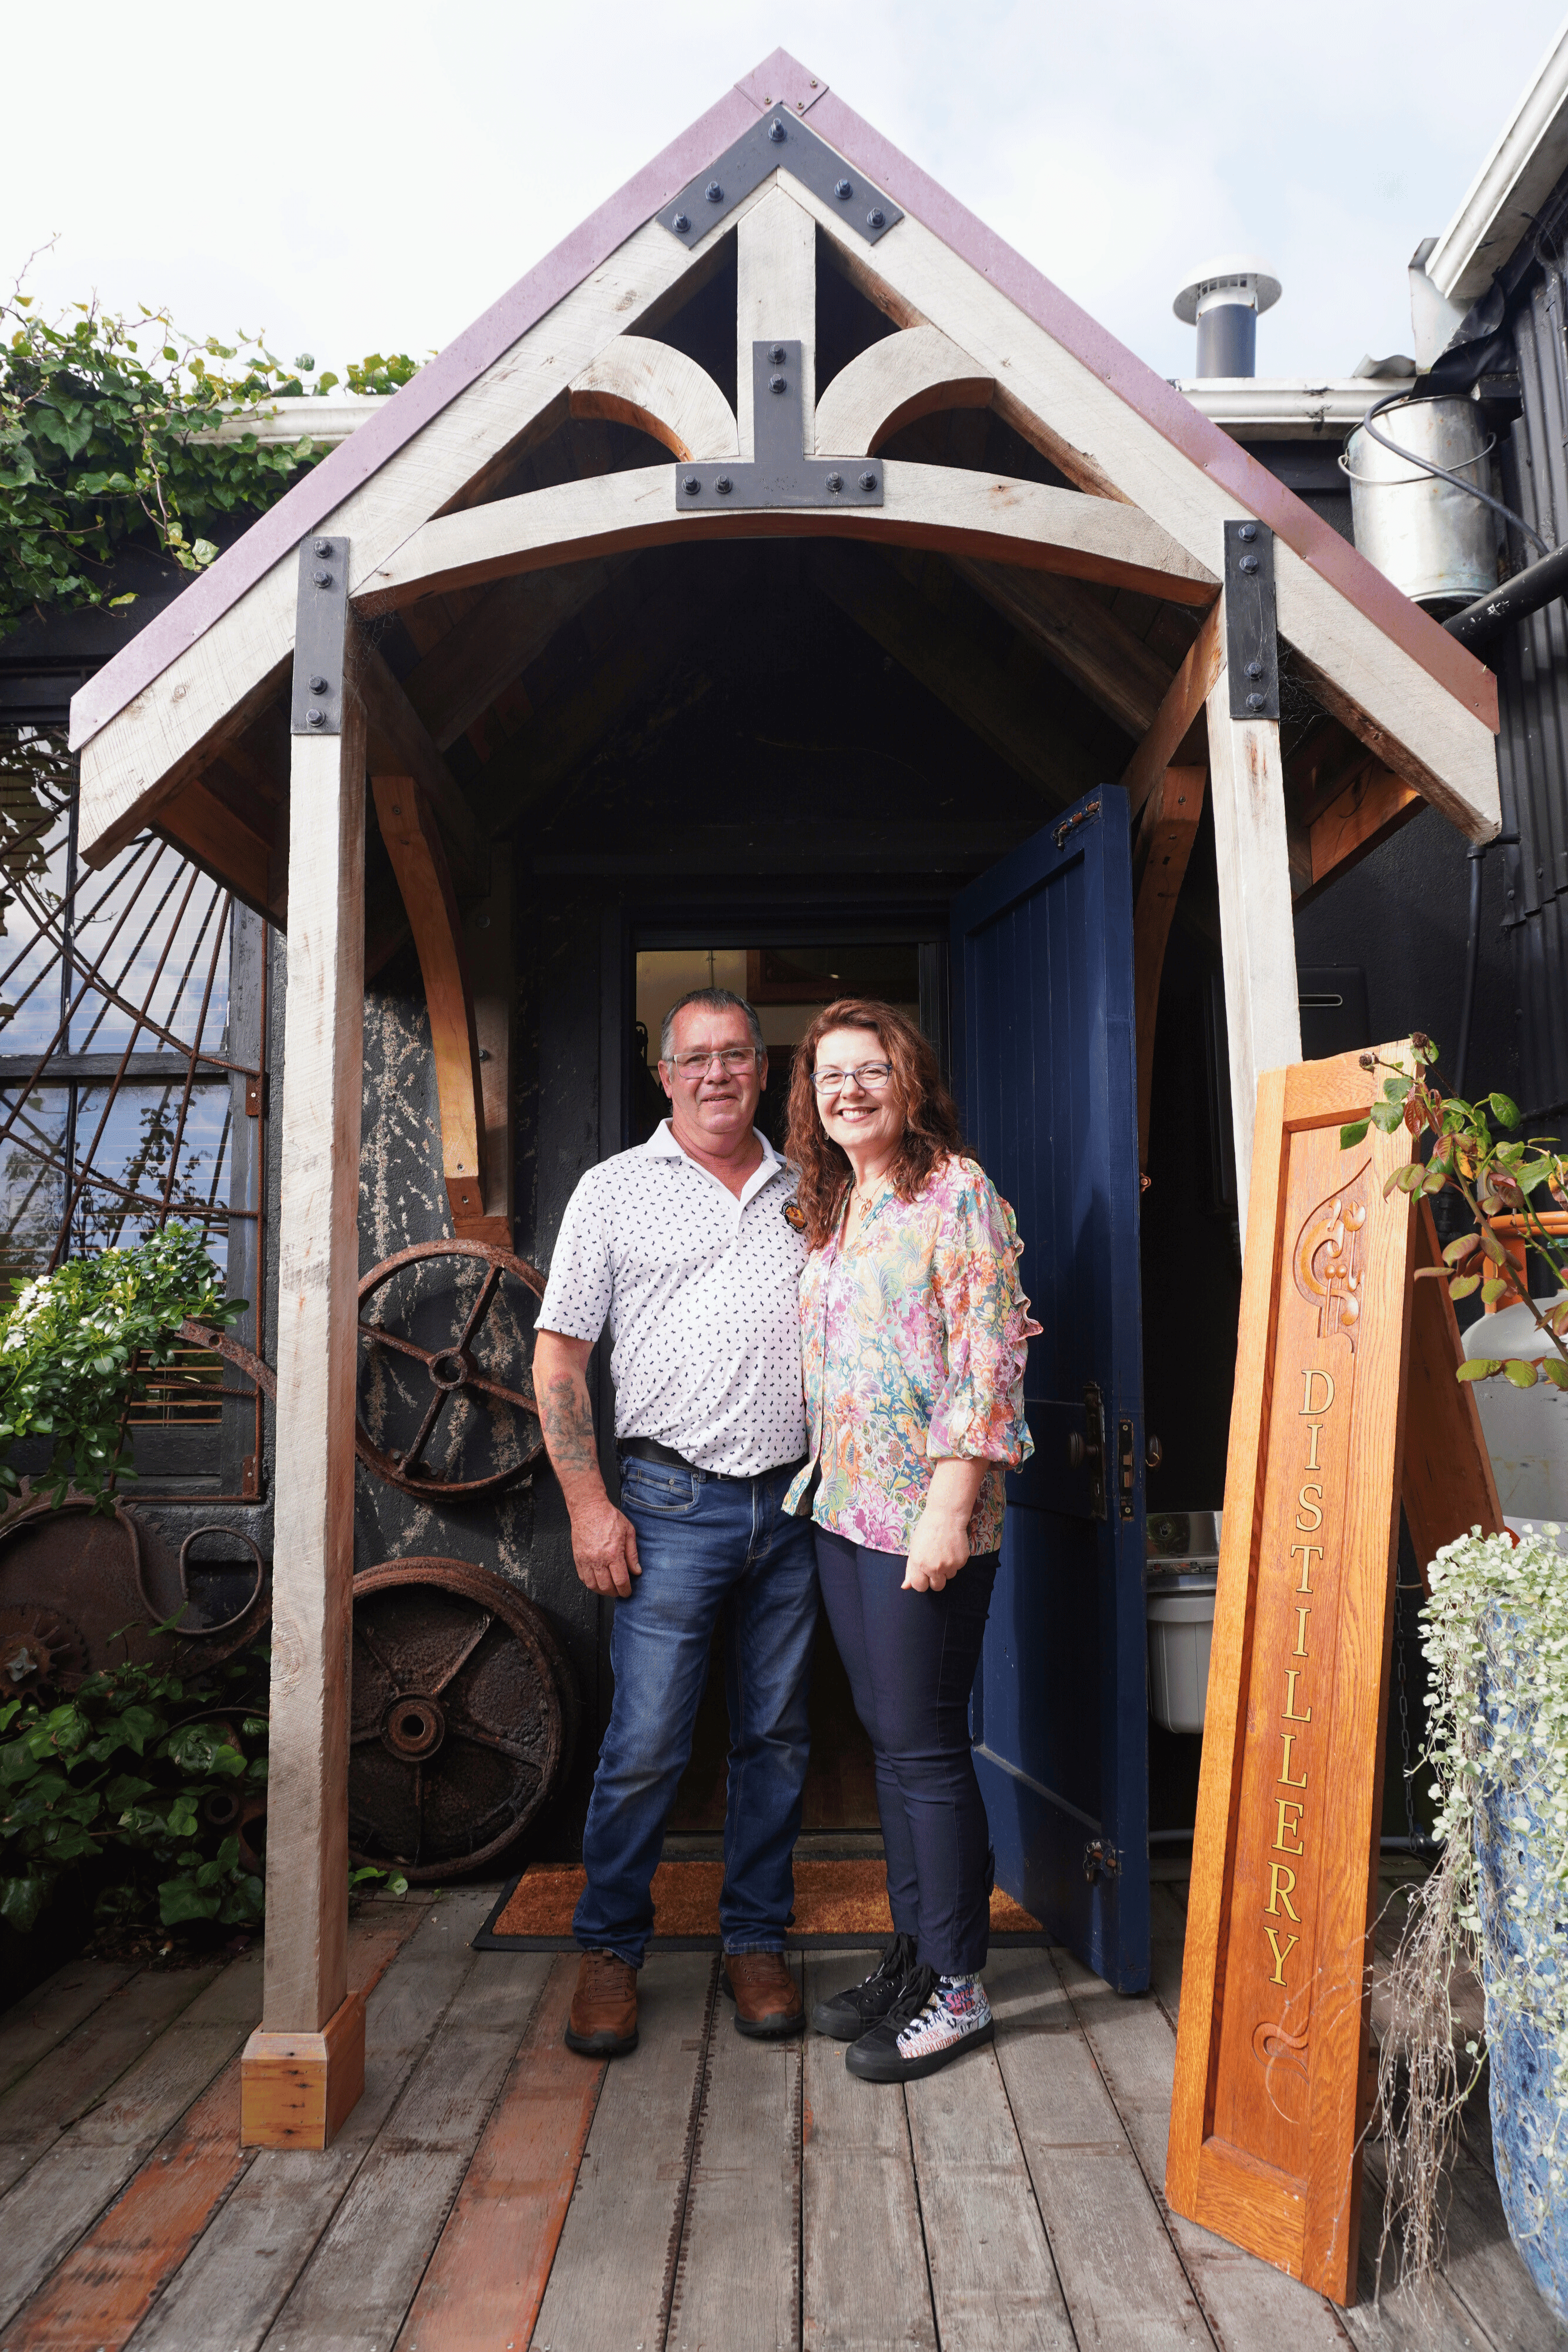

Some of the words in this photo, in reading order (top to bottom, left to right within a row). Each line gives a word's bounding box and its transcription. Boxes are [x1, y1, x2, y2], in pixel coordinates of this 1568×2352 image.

[1263, 1369, 1335, 1987] DISTILLERY
[914, 2028, 943, 2045] QUEENS
[915, 2043, 936, 2057] EACH
[935, 2032, 960, 2050] OTHERS
